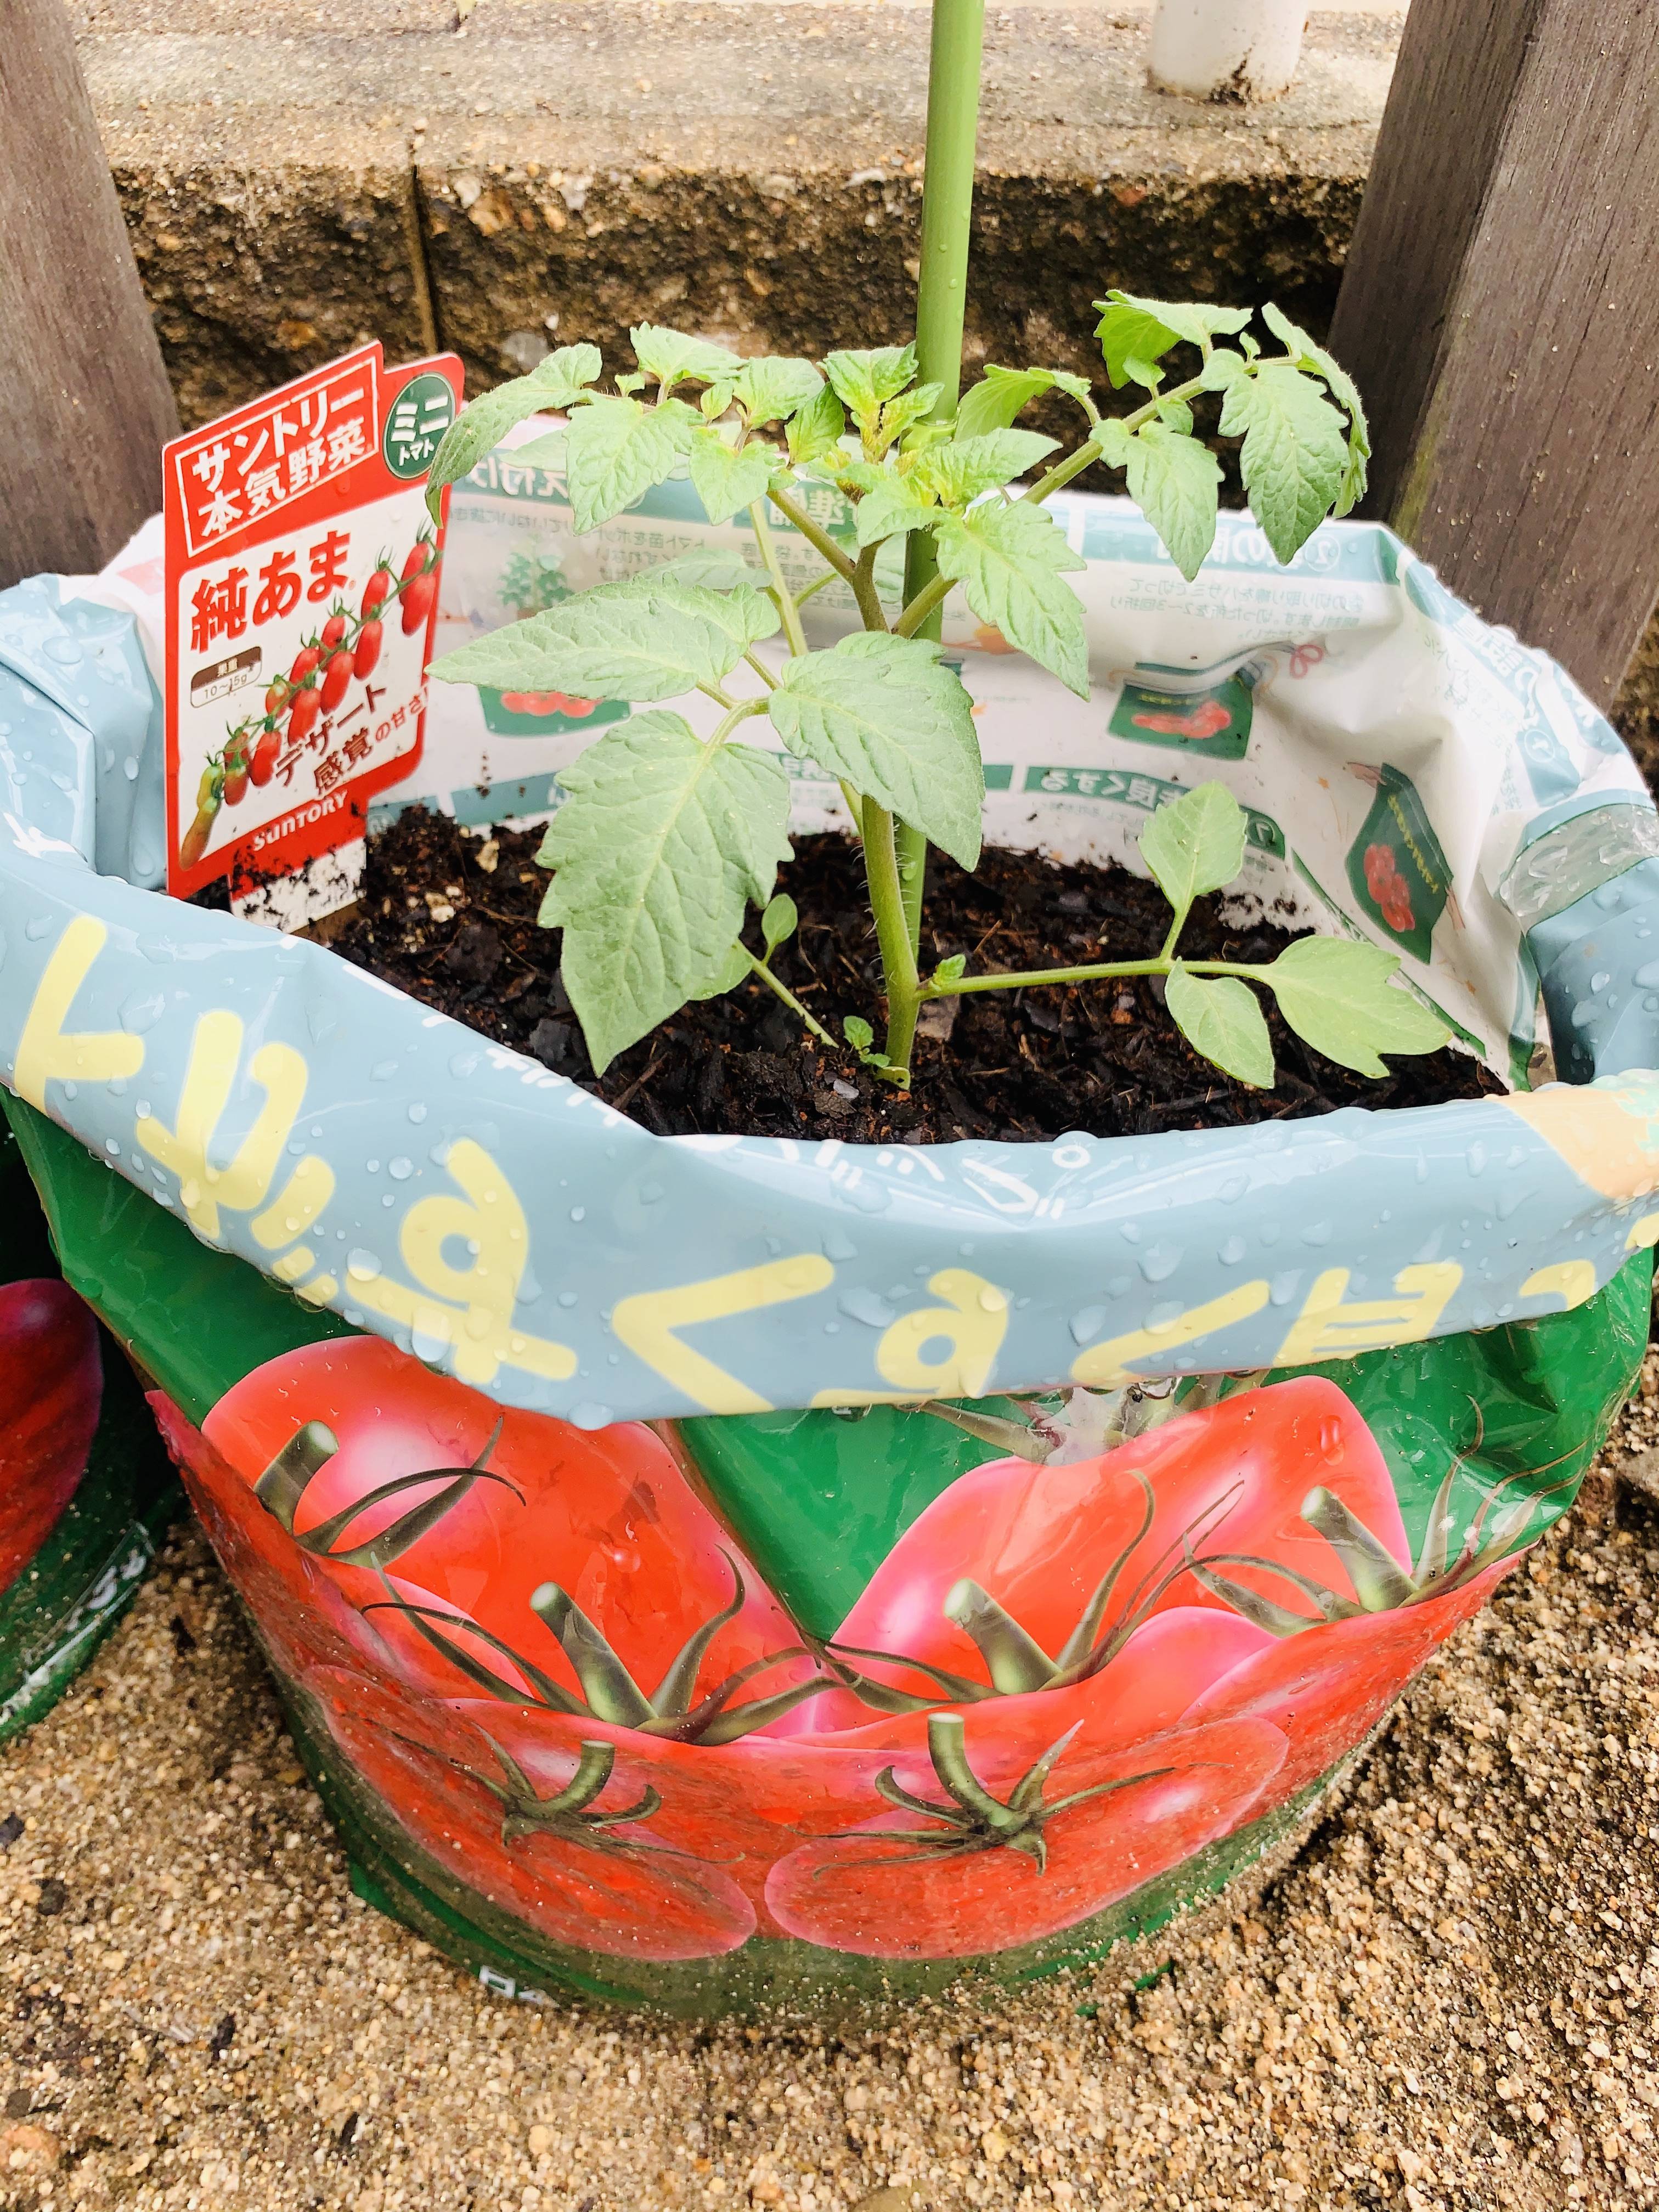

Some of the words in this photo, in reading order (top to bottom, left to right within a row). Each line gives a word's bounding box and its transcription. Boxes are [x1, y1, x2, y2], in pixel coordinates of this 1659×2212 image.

[193, 387, 364, 493] サントリー
[391, 394, 449, 442] ミニ
[399, 439, 434, 466] トマト
[198, 415, 366, 537] 本気野菜
[190, 530, 351, 653] 純あま
[276, 684, 386, 786] デザート
[253, 790, 348, 851] SUNTORY
